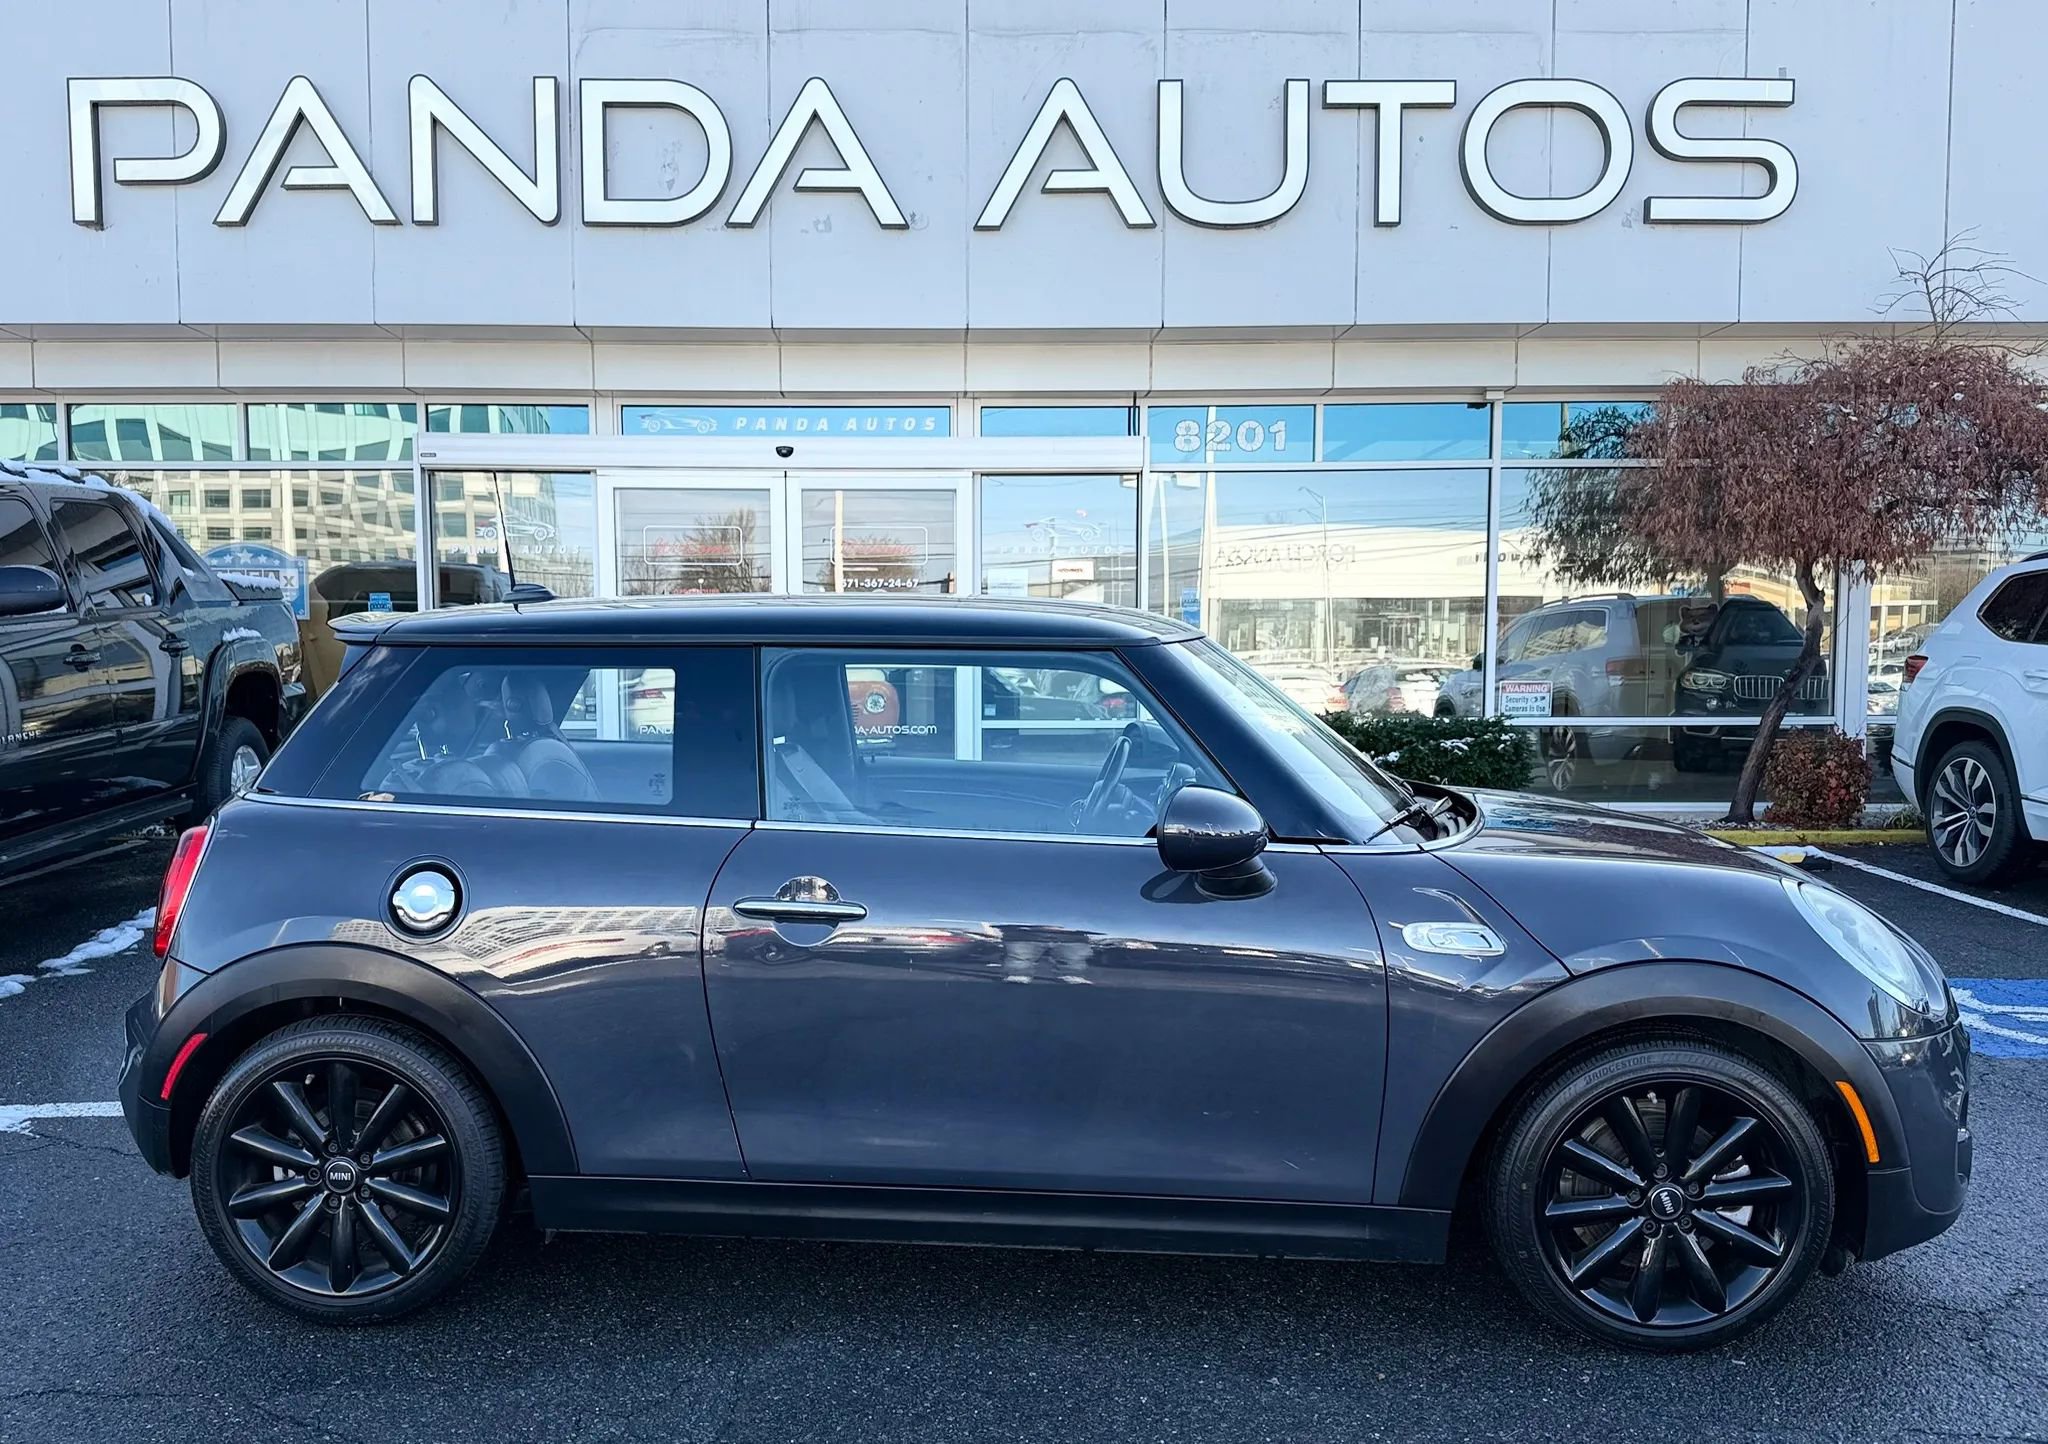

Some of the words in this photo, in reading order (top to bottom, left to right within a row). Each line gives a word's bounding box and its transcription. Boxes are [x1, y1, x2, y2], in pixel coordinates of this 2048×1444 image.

[67, 74, 910, 231] PANDA
[973, 77, 1800, 231] AUTOS
[734, 416, 829, 431] PANDA
[845, 416, 936, 431] AUTOS
[1173, 419, 1287, 453] 8201
[450, 544, 510, 555] PAND
[521, 545, 581, 555] AUTOS
[1067, 545, 1124, 555] AUTOS
[1504, 683, 1548, 693] WARNING
[1505, 695, 1529, 704] Security
[1504, 704, 1528, 712] Cameras
[0, 729, 42, 745] LANCHE
[1583, 1055, 1654, 1085] BRIDGESTONE
[330, 1172, 351, 1181] MINI
[1659, 1191, 1674, 1214] MINI
